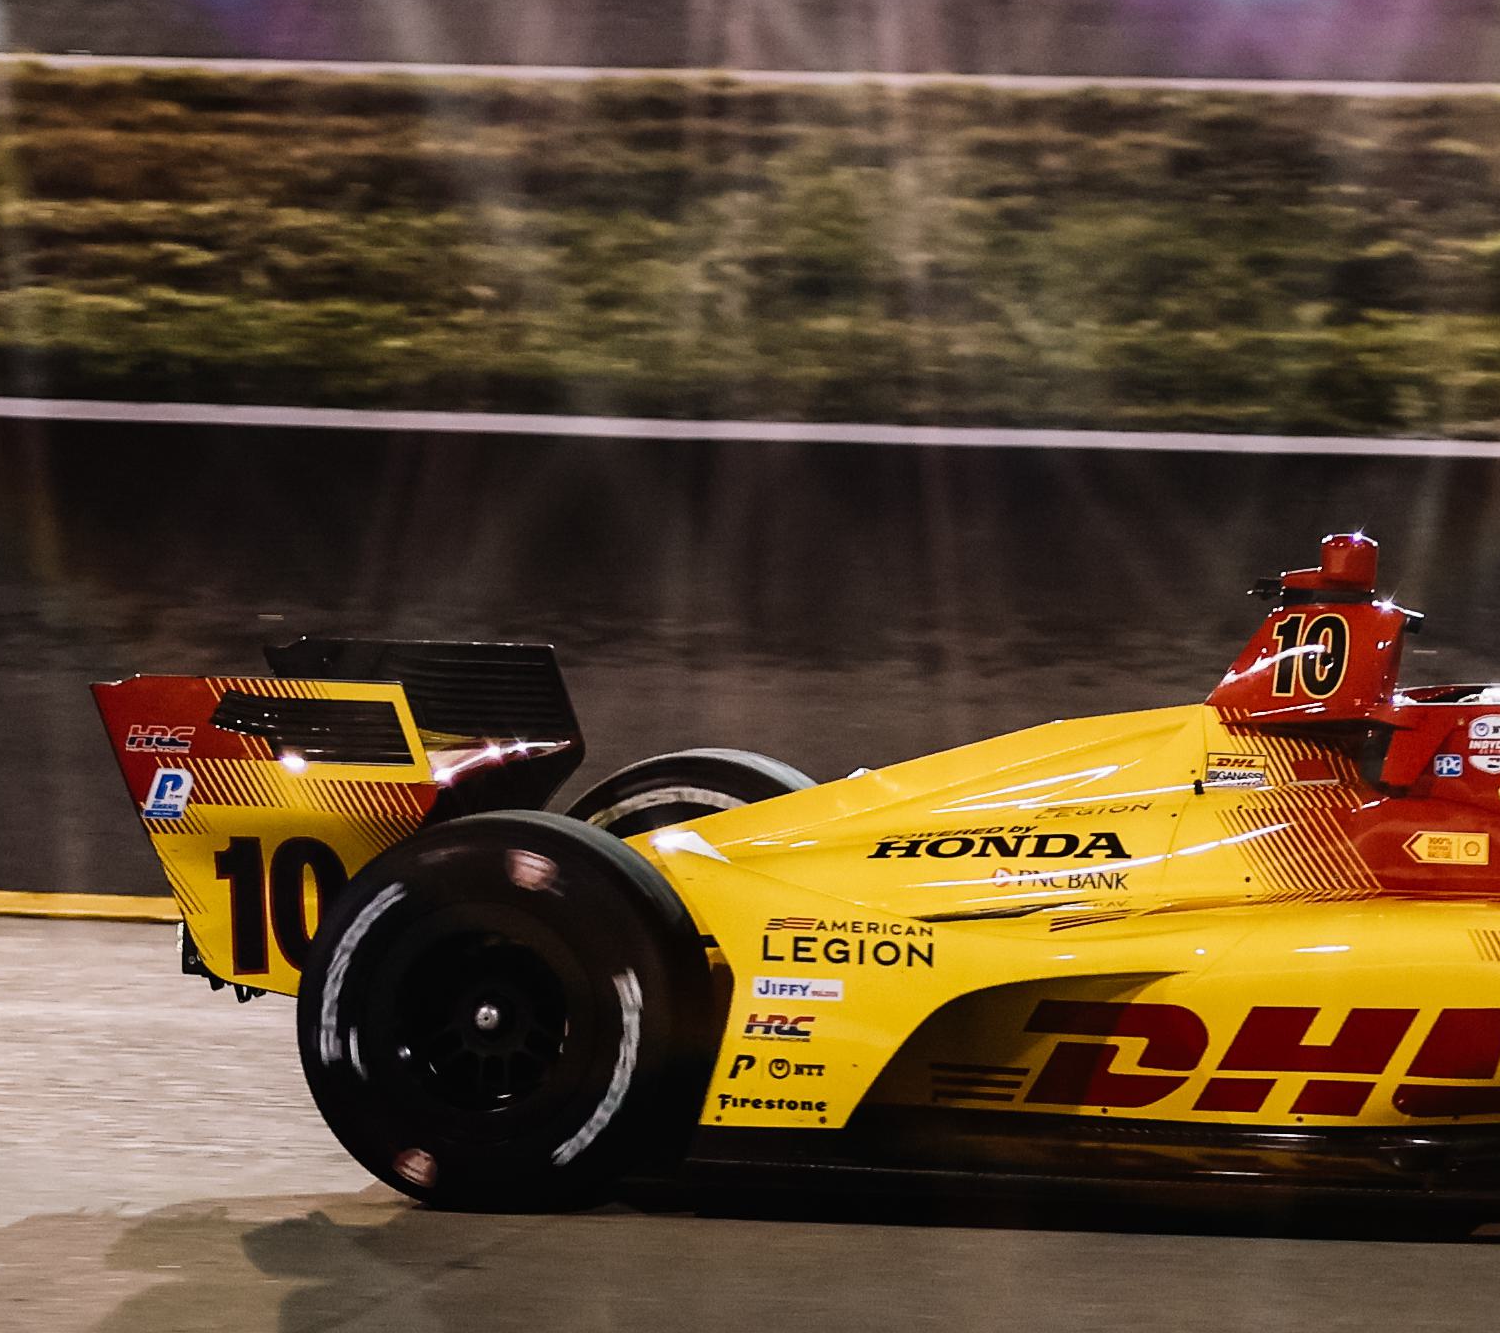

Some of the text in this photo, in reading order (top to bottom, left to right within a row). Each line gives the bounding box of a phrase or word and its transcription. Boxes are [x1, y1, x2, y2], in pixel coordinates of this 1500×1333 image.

[1271, 614, 1350, 699] 10
[126, 725, 196, 748] HRC
[1216, 758, 1257, 767] DHL
[1034, 803, 1153, 819] LEGION
[881, 826, 1004, 840] POWERED
[867, 832, 1132, 859] HONDA
[1068, 870, 1129, 891] BANK
[214, 836, 350, 976] 10
[815, 920, 933, 937] AMERICAN
[762, 935, 934, 968] LEGION
[758, 979, 810, 997] JIFFY
[744, 1013, 816, 1037] HRC
[794, 1064, 825, 1076] NTT
[718, 1094, 827, 1112] Firestone
